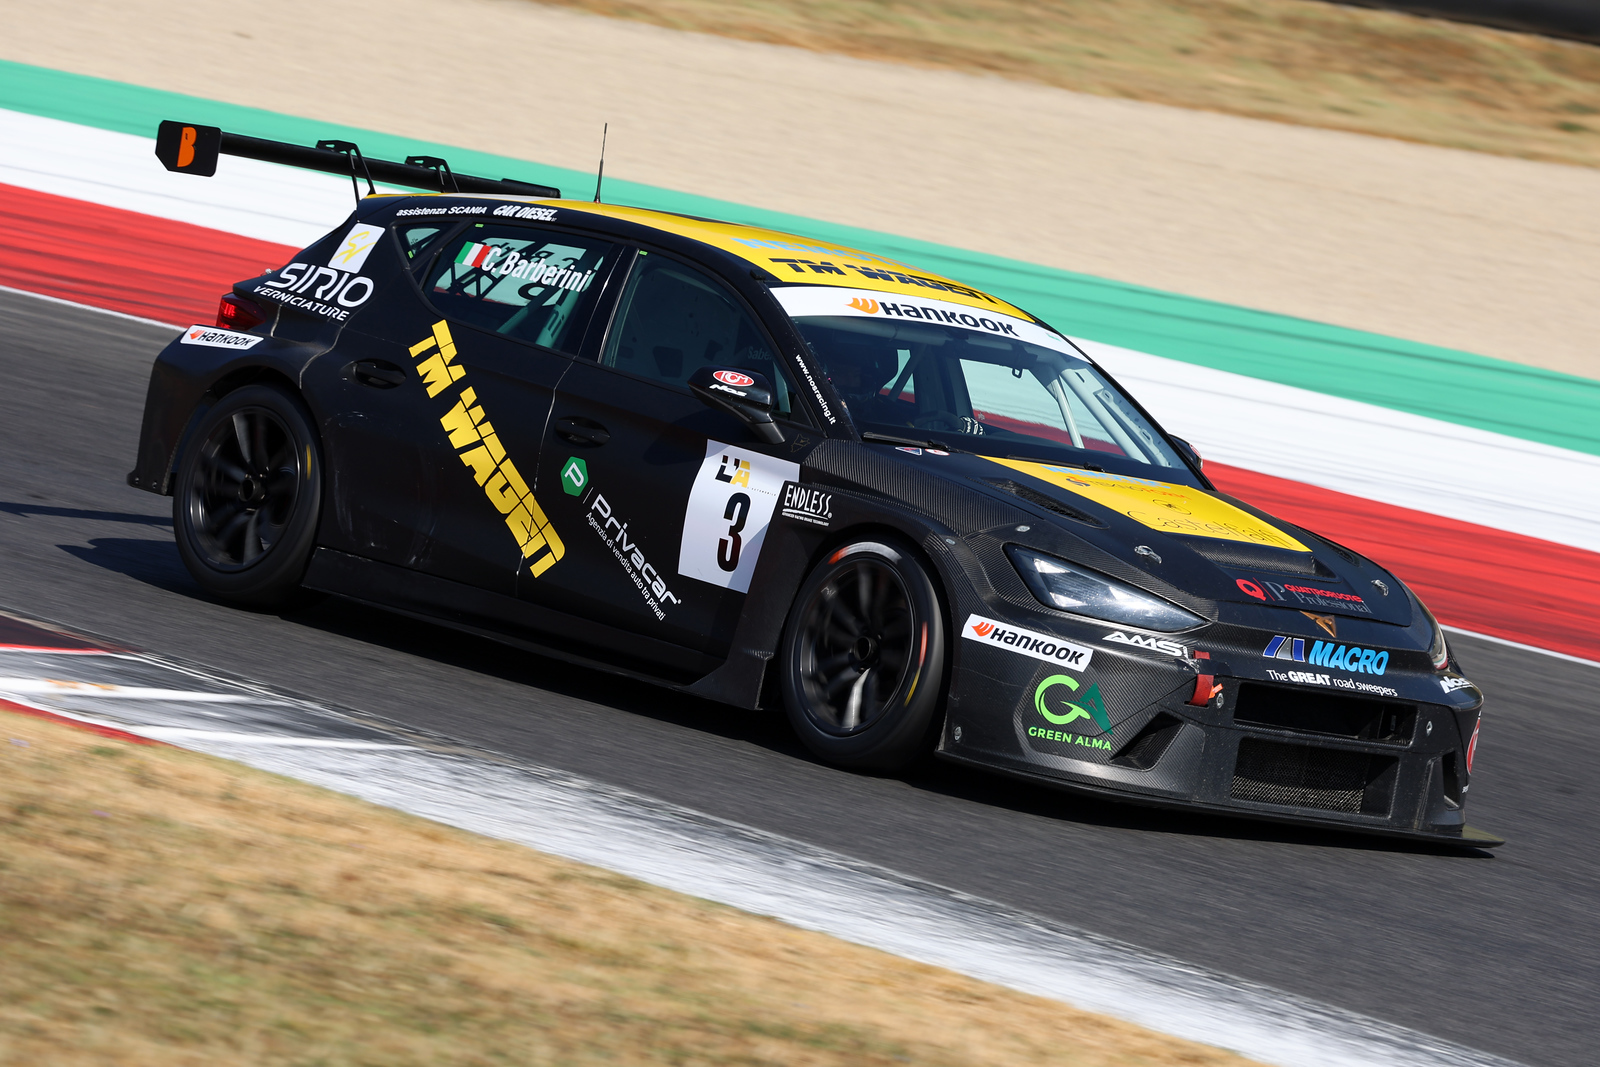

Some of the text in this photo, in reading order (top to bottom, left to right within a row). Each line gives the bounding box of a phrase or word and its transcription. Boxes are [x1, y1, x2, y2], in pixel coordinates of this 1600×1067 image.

[396, 207, 447, 217] assistenza
[447, 206, 488, 215] SCANIA
[493, 205, 521, 217] CAR
[515, 206, 558, 221] DIESEL
[264, 262, 375, 308] SIRIO
[481, 246, 498, 273] C.
[502, 250, 592, 294] Barberini
[768, 257, 848, 276] TM
[253, 285, 350, 322] VERNICIATURE
[408, 319, 466, 399] TM
[795, 354, 837, 425] www.nosracing.it
[440, 386, 566, 579] WAGEN
[784, 484, 832, 516] ENDLESS
[591, 493, 678, 605] Privacar
[717, 492, 751, 572] 3
[586, 512, 667, 621] Agenzia di vendita auto tra privati
[1308, 639, 1389, 676] MACRO
[1265, 669, 1398, 697] The GREAT road sweepers
[1028, 726, 1112, 751] GREEN ALMA
